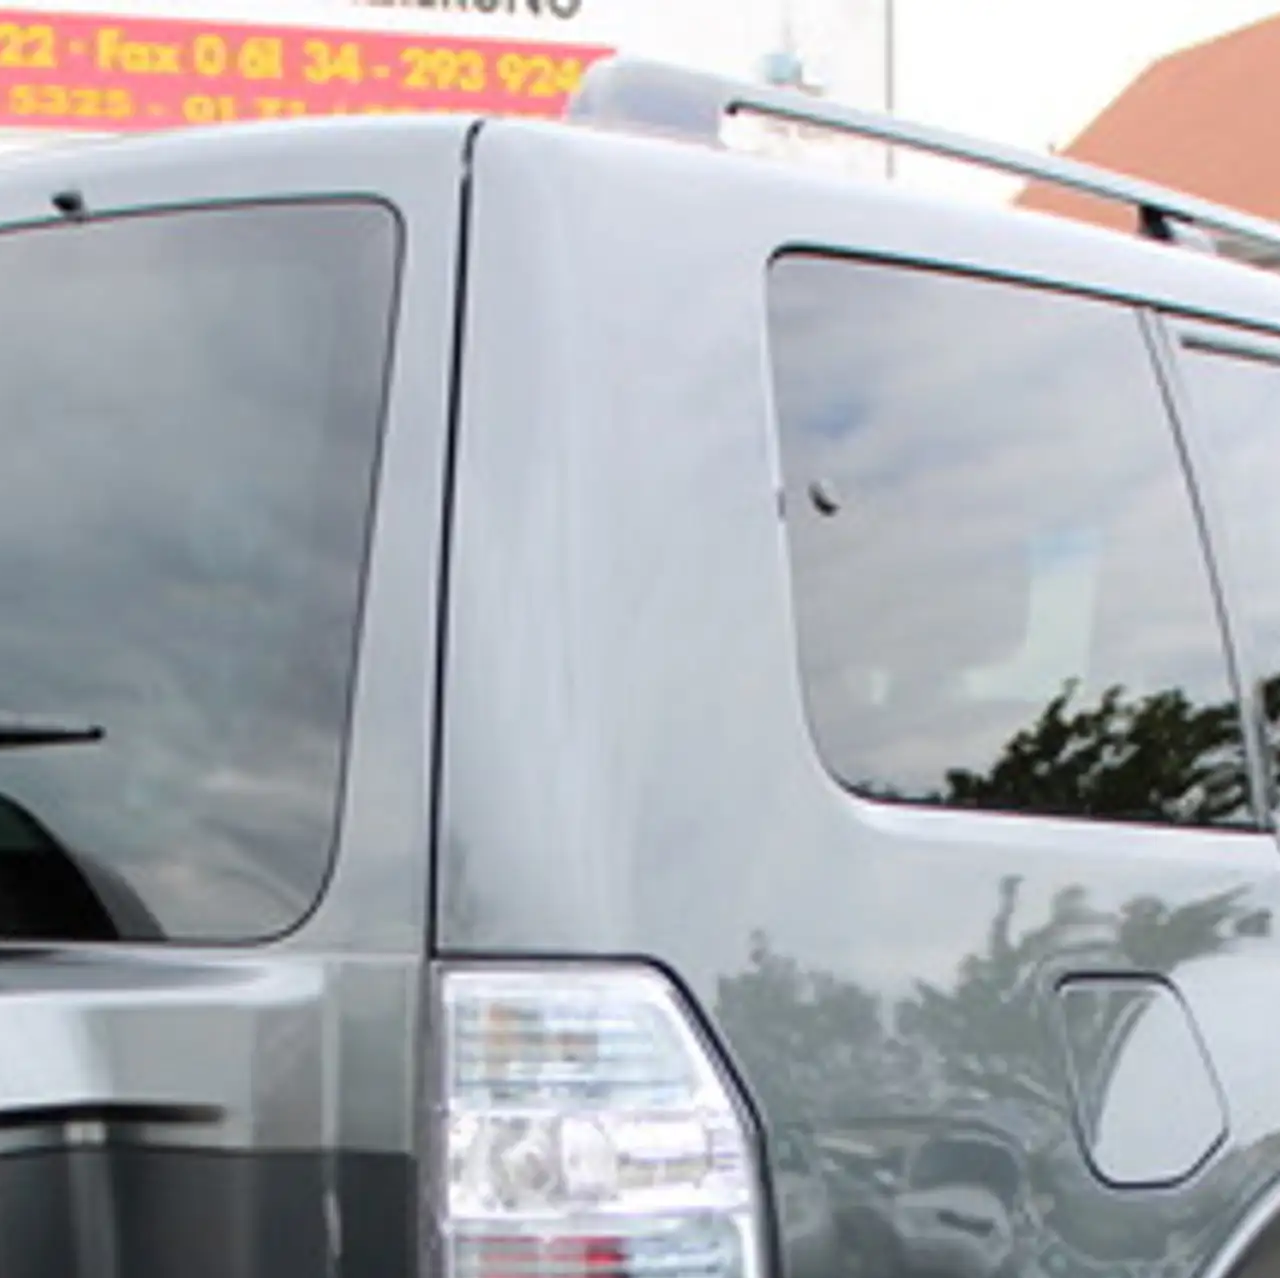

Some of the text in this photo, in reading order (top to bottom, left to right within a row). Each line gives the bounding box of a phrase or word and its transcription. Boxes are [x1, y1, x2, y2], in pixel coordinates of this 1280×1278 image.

[95, 27, 182, 75] Fax
[193, 33, 227, 77] 0
[236, 36, 285, 80] 61
[302, 39, 366, 84] 34
[399, 46, 488, 93] 293
